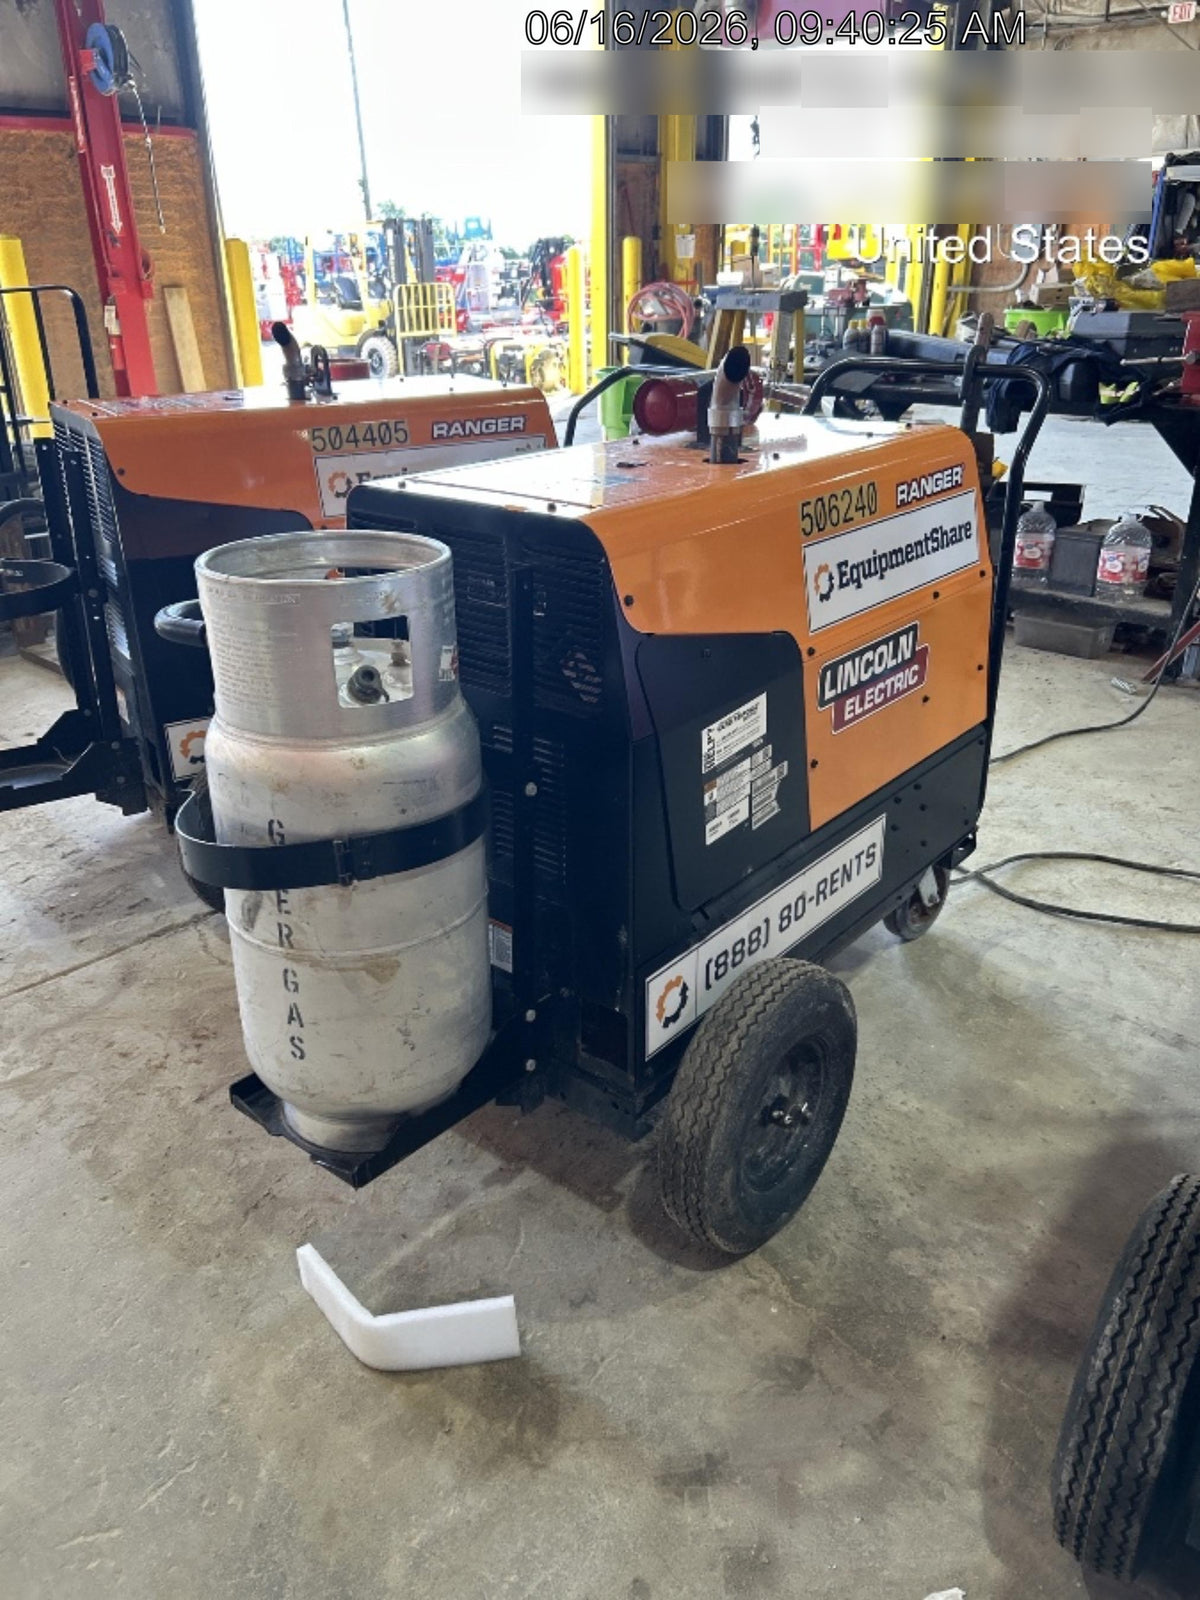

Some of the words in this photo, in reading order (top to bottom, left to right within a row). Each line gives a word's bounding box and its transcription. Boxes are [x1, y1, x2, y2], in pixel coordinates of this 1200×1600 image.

[311, 420, 409, 451] 504405
[432, 416, 525, 438] RANGER
[801, 481, 878, 537] 506240
[896, 464, 963, 507] RANGER
[836, 521, 972, 590] EquipmentShare
[824, 630, 915, 701] LINCOLN
[844, 664, 919, 721] ELECTRIC
[705, 917, 771, 991] (888)
[778, 842, 877, 934] 80-RENTS
